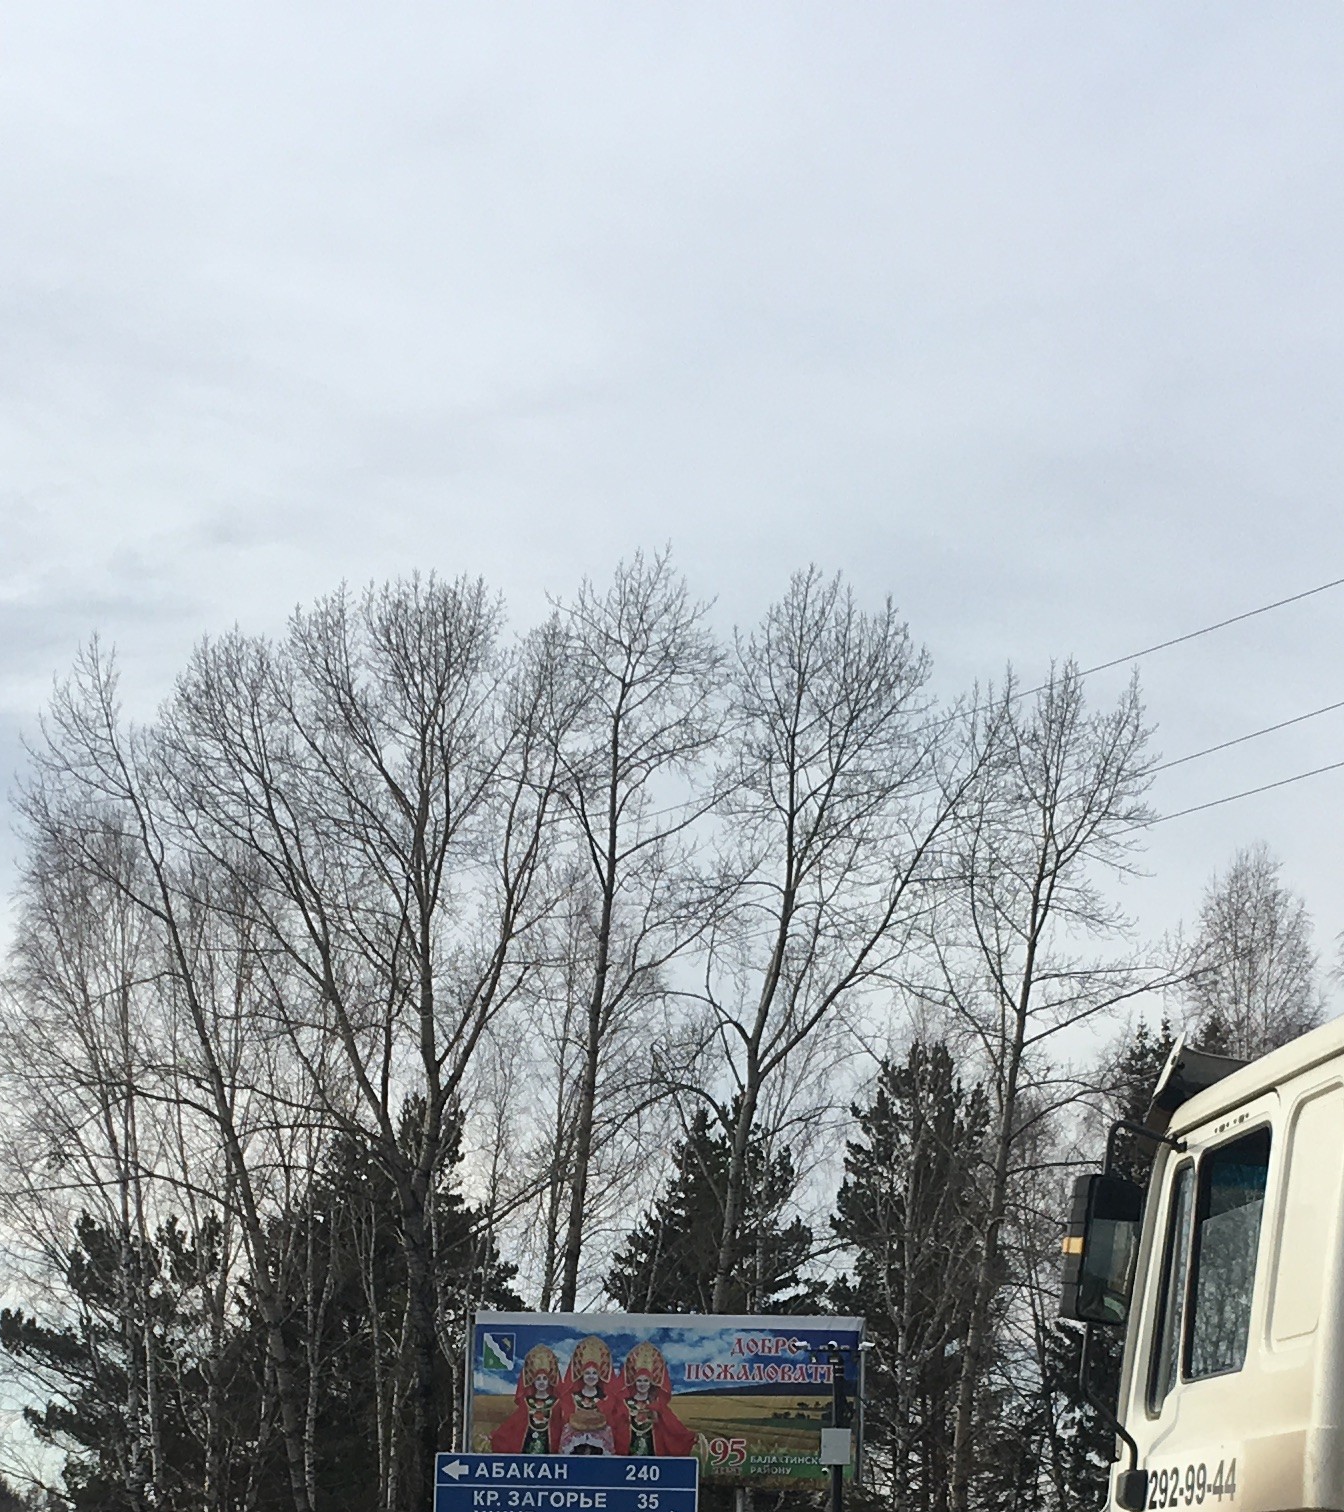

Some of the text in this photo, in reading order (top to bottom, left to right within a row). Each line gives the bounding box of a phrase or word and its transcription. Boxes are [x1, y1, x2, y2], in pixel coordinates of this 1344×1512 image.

[730, 1337, 799, 1357] ДОБРО
[709, 1437, 747, 1467] 95
[474, 1462, 660, 1481] АБАКАН 240
[750, 1464, 792, 1475] РАЙОНУ
[1148, 1457, 1237, 1510] 292-99-44
[472, 1490, 659, 1509] КР. ЗАГОРЬЕ 35
